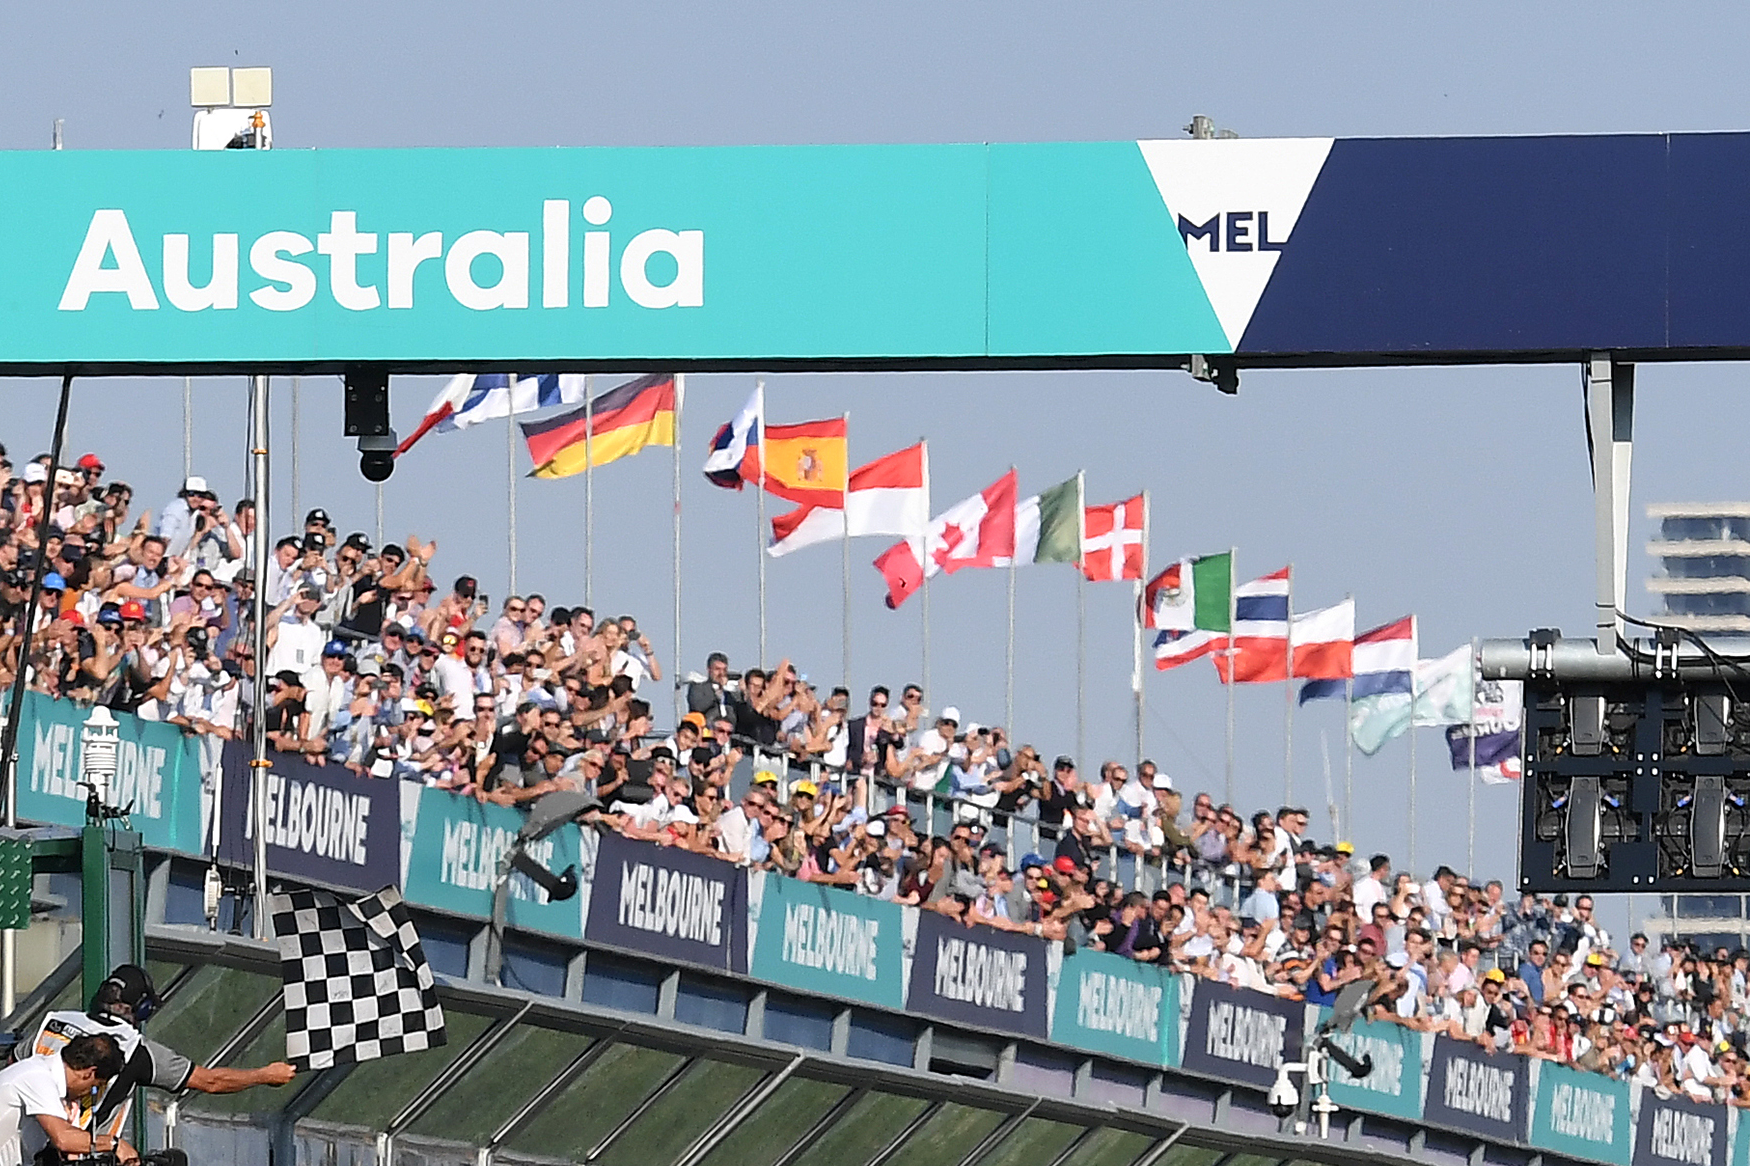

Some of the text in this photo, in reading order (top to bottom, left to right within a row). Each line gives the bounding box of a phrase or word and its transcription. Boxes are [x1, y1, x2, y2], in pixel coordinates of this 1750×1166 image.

[57, 195, 705, 311] Australia
[1178, 211, 1286, 253] MEL
[30, 717, 166, 819] MELURNE
[619, 860, 725, 946] MELBOURNE
[782, 902, 878, 981] MELBOURNE
[935, 935, 1027, 1012] MELBOURNE
